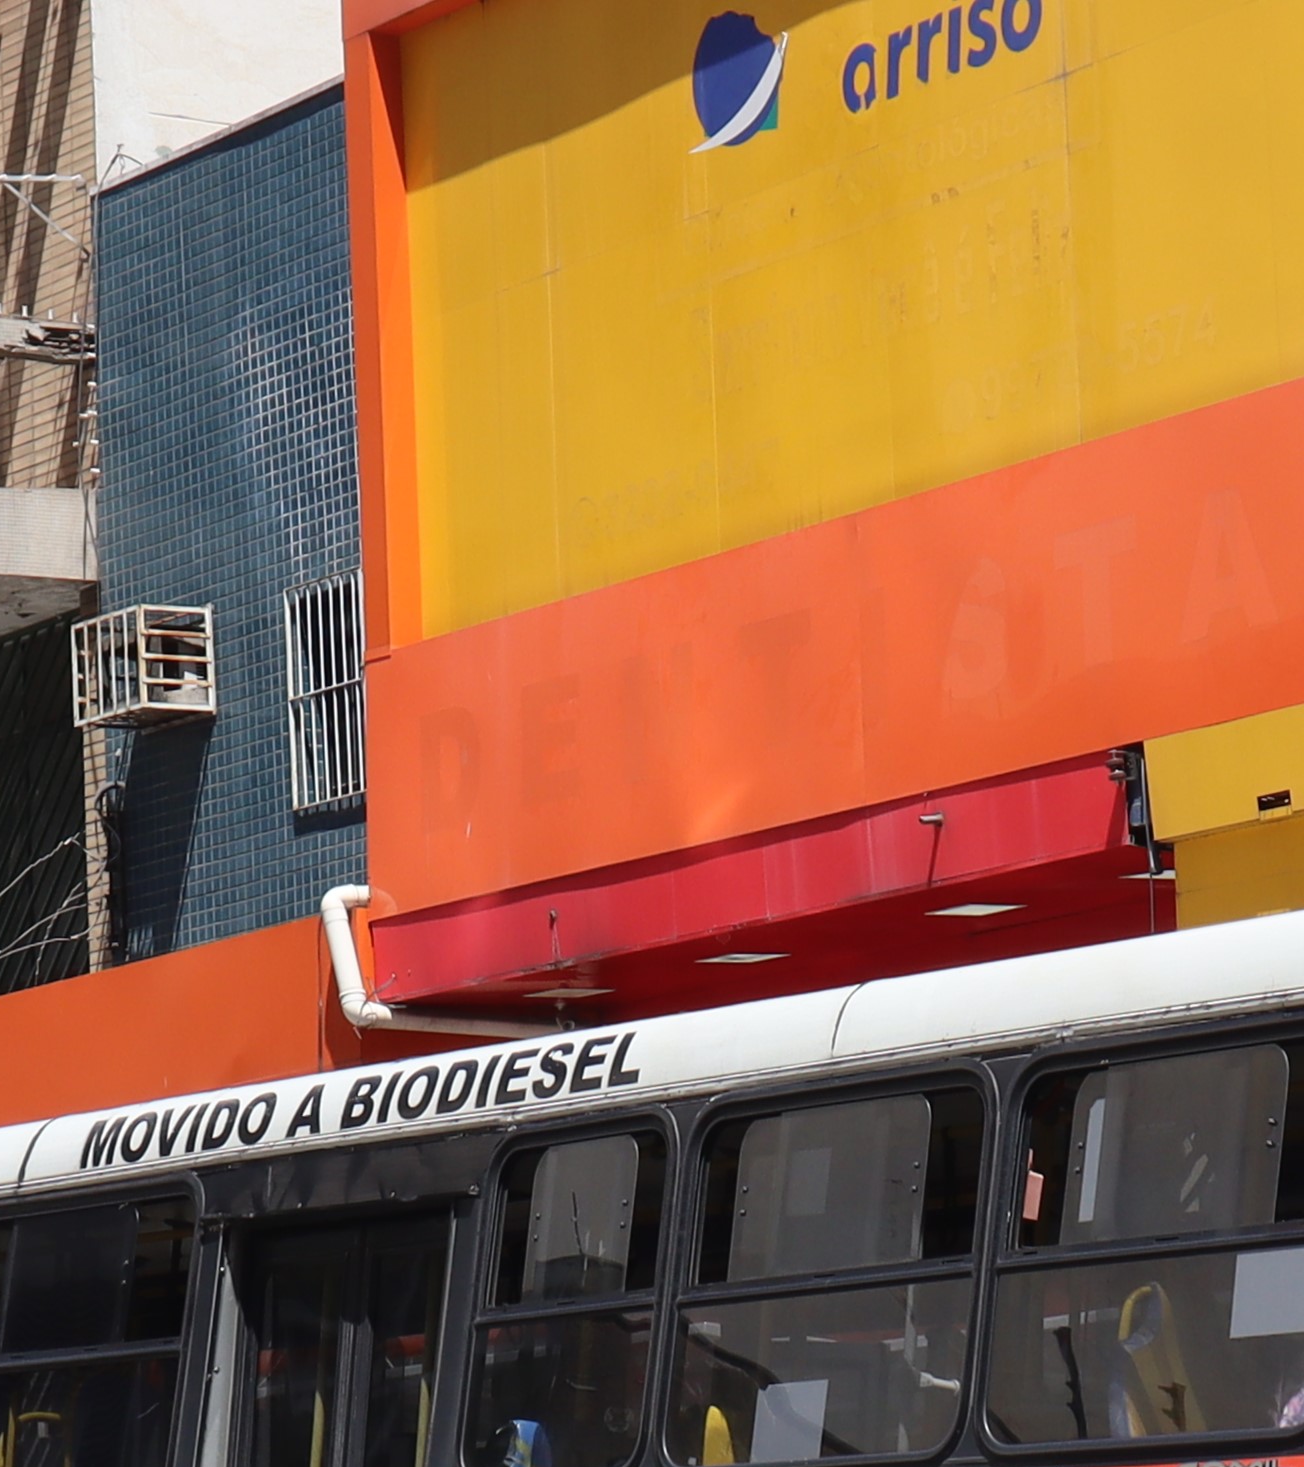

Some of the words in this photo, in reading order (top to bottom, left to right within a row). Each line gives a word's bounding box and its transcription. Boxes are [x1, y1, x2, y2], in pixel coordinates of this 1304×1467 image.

[79, 1092, 278, 1169] MOVIDO
[285, 1084, 326, 1138] A
[339, 1031, 641, 1130] BIODIESEL
